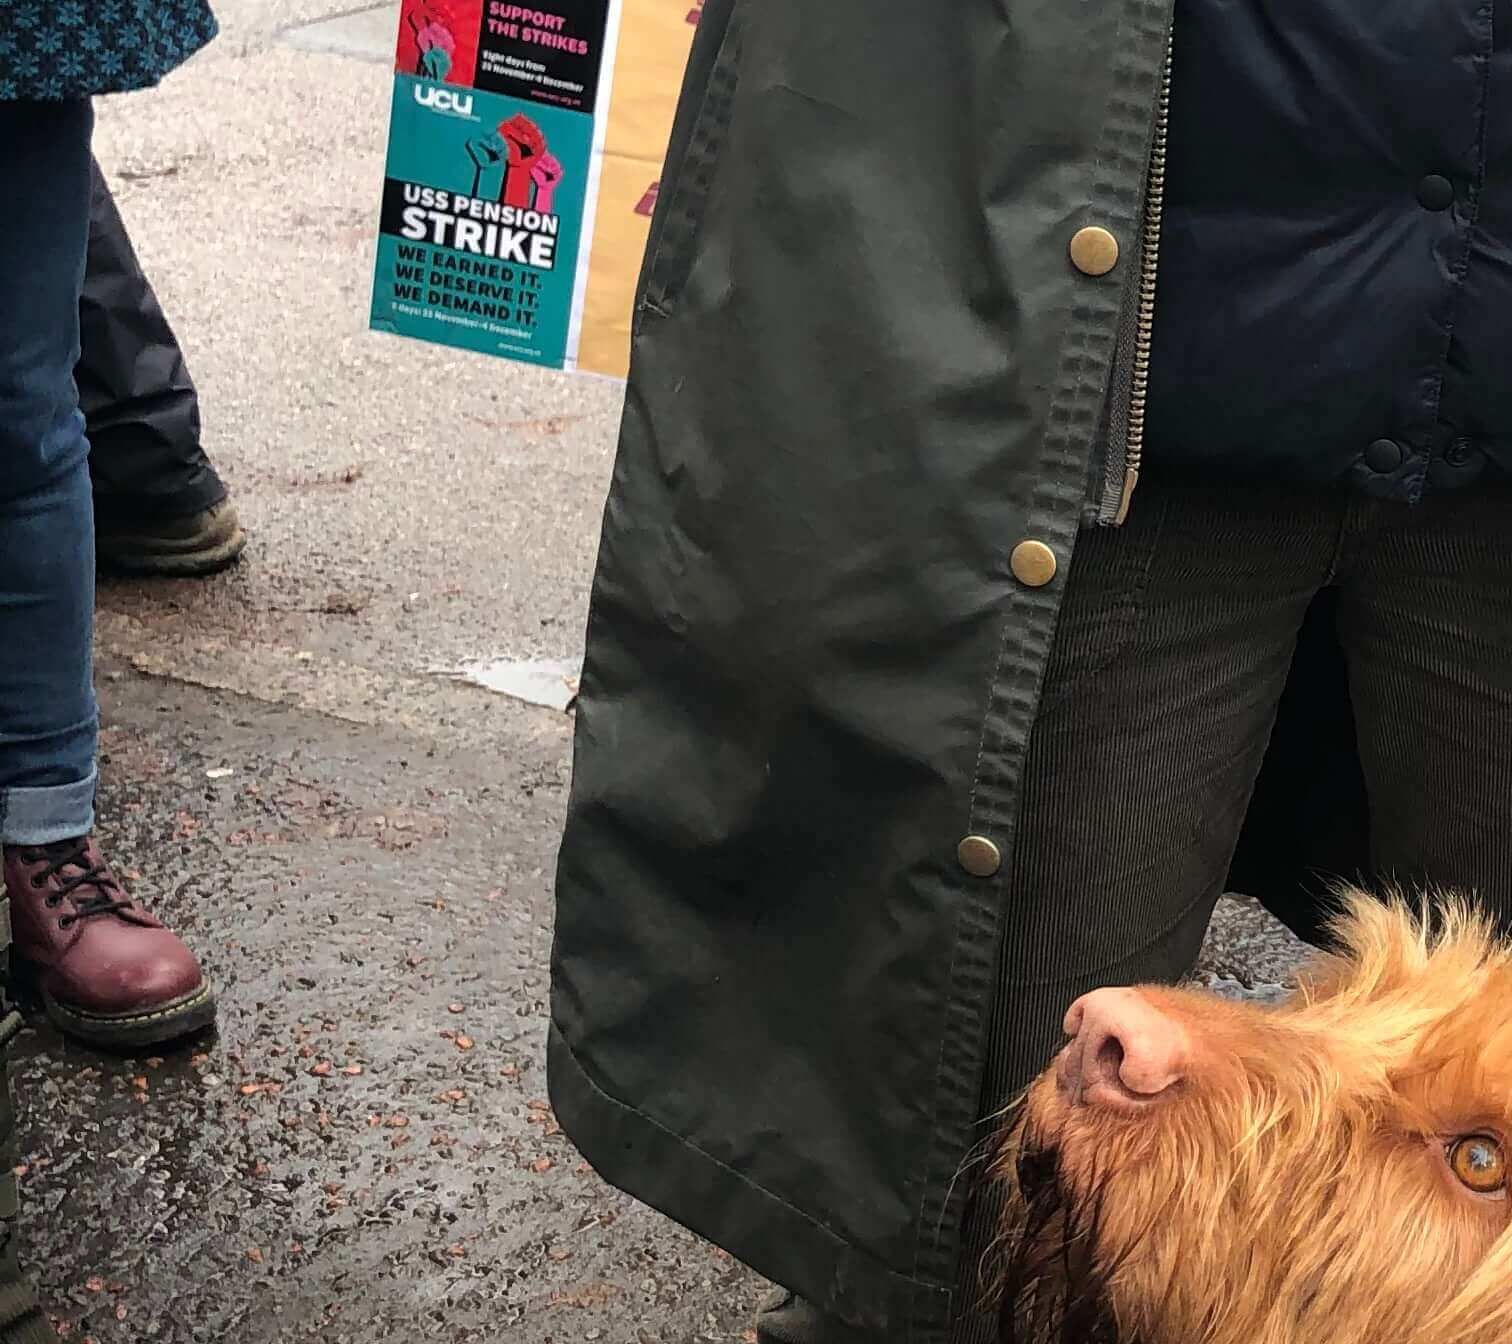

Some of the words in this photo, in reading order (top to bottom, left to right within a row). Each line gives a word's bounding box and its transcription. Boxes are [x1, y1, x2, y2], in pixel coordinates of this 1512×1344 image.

[487, 18, 519, 38] THE
[522, 27, 588, 55] STRIKES
[489, 0, 566, 31] SUPPORT
[526, 60, 546, 72] from
[403, 183, 449, 211] USS
[453, 195, 558, 234] PENSION
[401, 206, 555, 270] STRIKE
[396, 263, 425, 283] WE
[430, 271, 513, 302] DESERVE
[397, 244, 426, 262] WE
[433, 251, 514, 282] EARNED
[520, 271, 543, 290] IT.
[393, 283, 423, 302] WE
[428, 290, 510, 321] DEMAND
[516, 310, 538, 328] IT.
